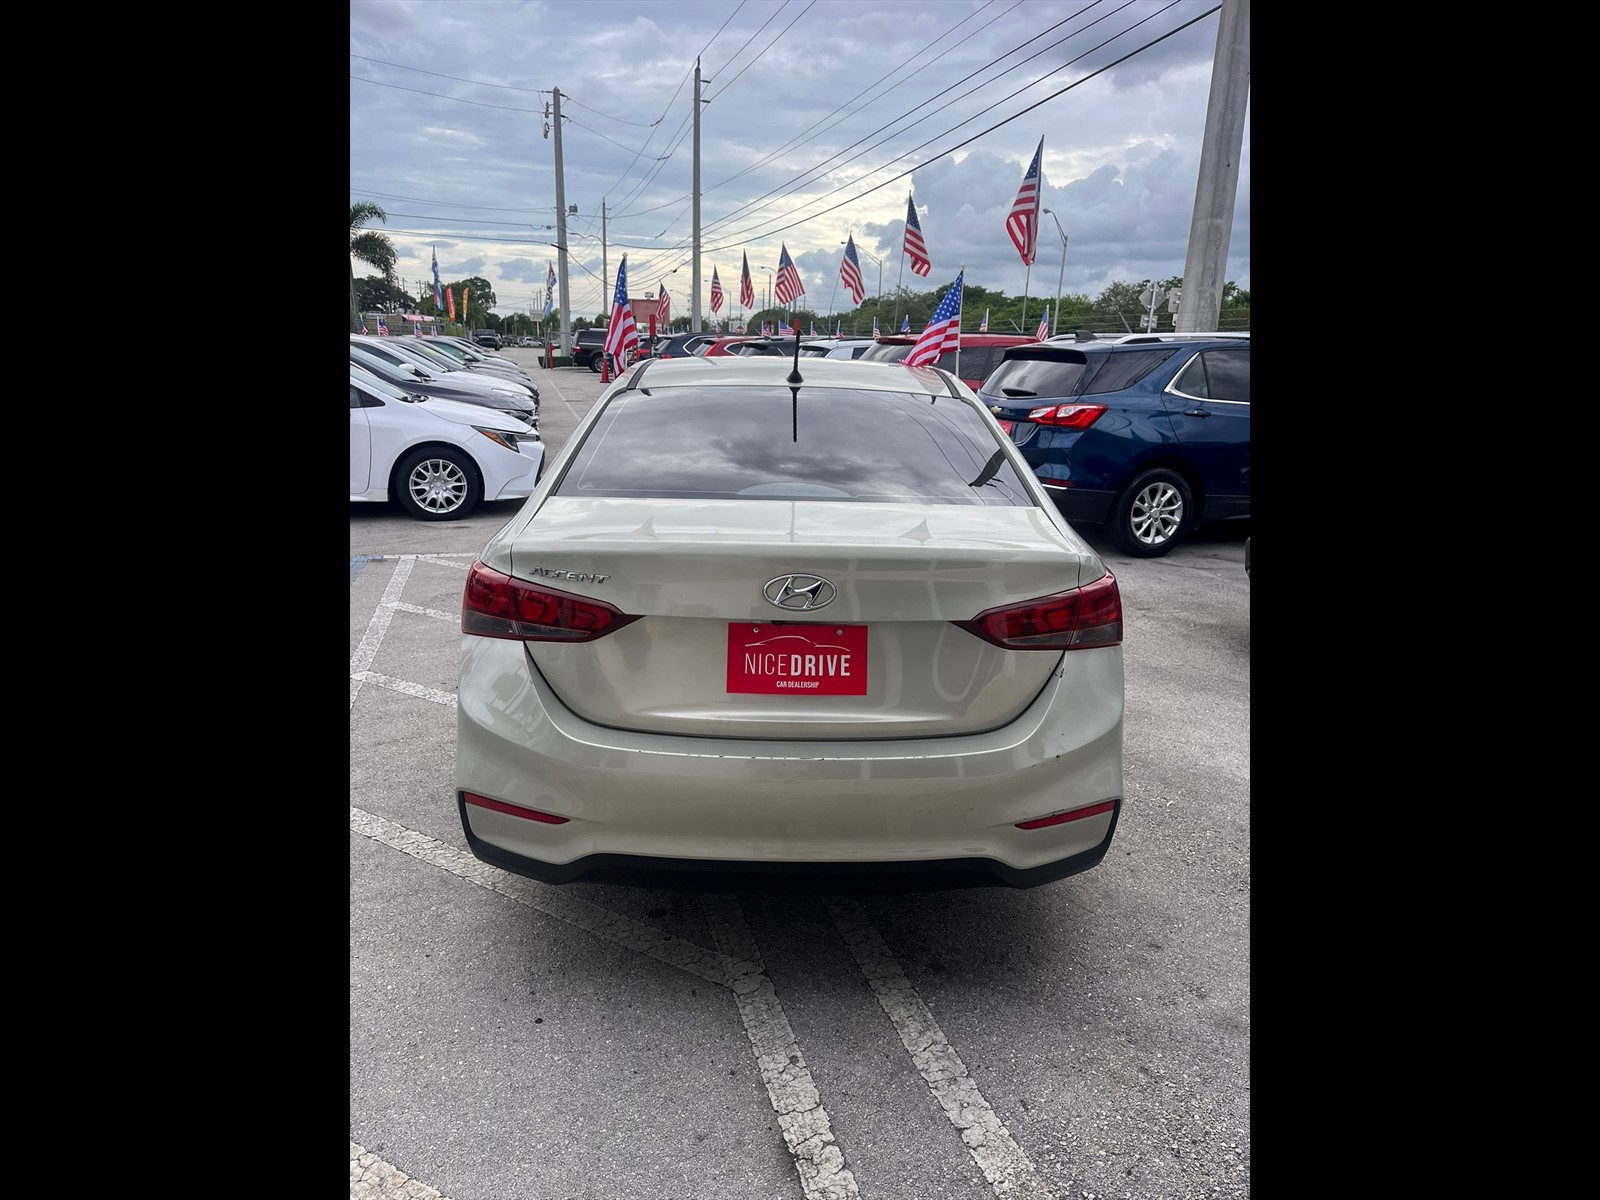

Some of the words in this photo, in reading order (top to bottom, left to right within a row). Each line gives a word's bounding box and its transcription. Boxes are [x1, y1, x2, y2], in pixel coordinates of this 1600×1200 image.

[529, 566, 611, 584] ACCENT
[776, 680, 787, 688] CAR
[788, 681, 820, 689] DEALERSHIP
